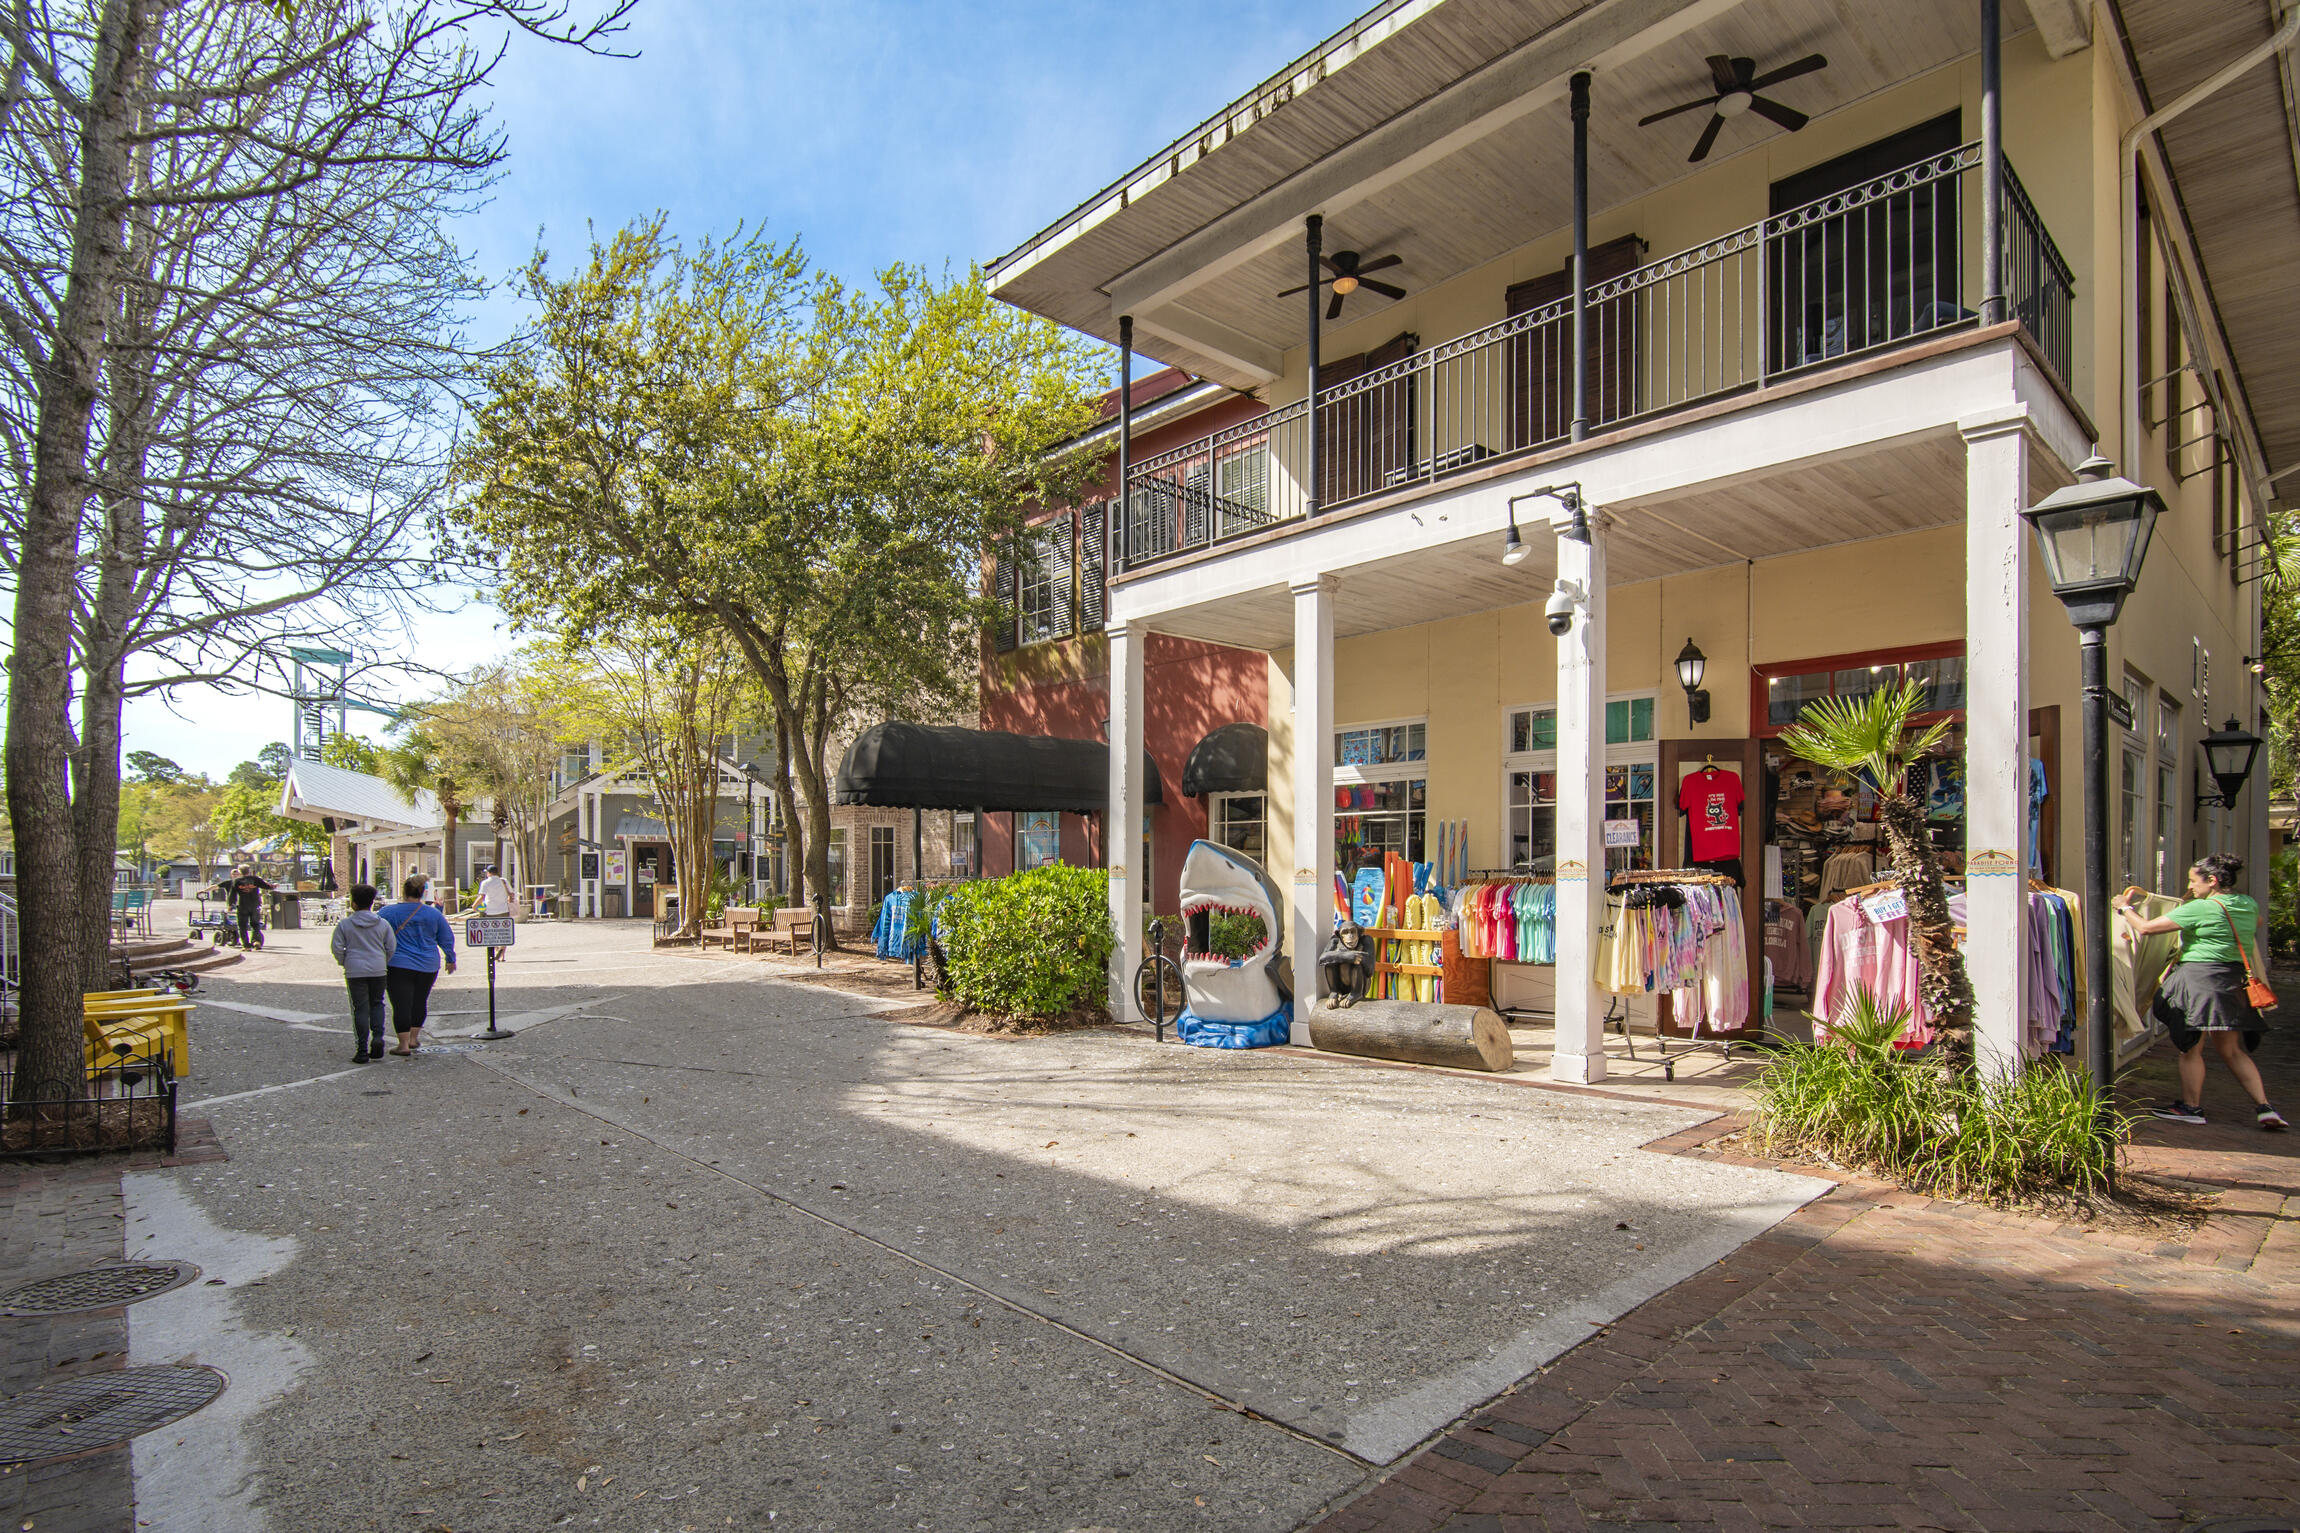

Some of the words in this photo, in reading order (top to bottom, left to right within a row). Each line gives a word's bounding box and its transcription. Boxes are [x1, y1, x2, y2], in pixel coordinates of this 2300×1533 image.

[1606, 831, 1637, 845] CLEARANCE
[1873, 906, 1887, 915] BUY
[1892, 900, 1905, 909] GET
[470, 929, 483, 944] NO
